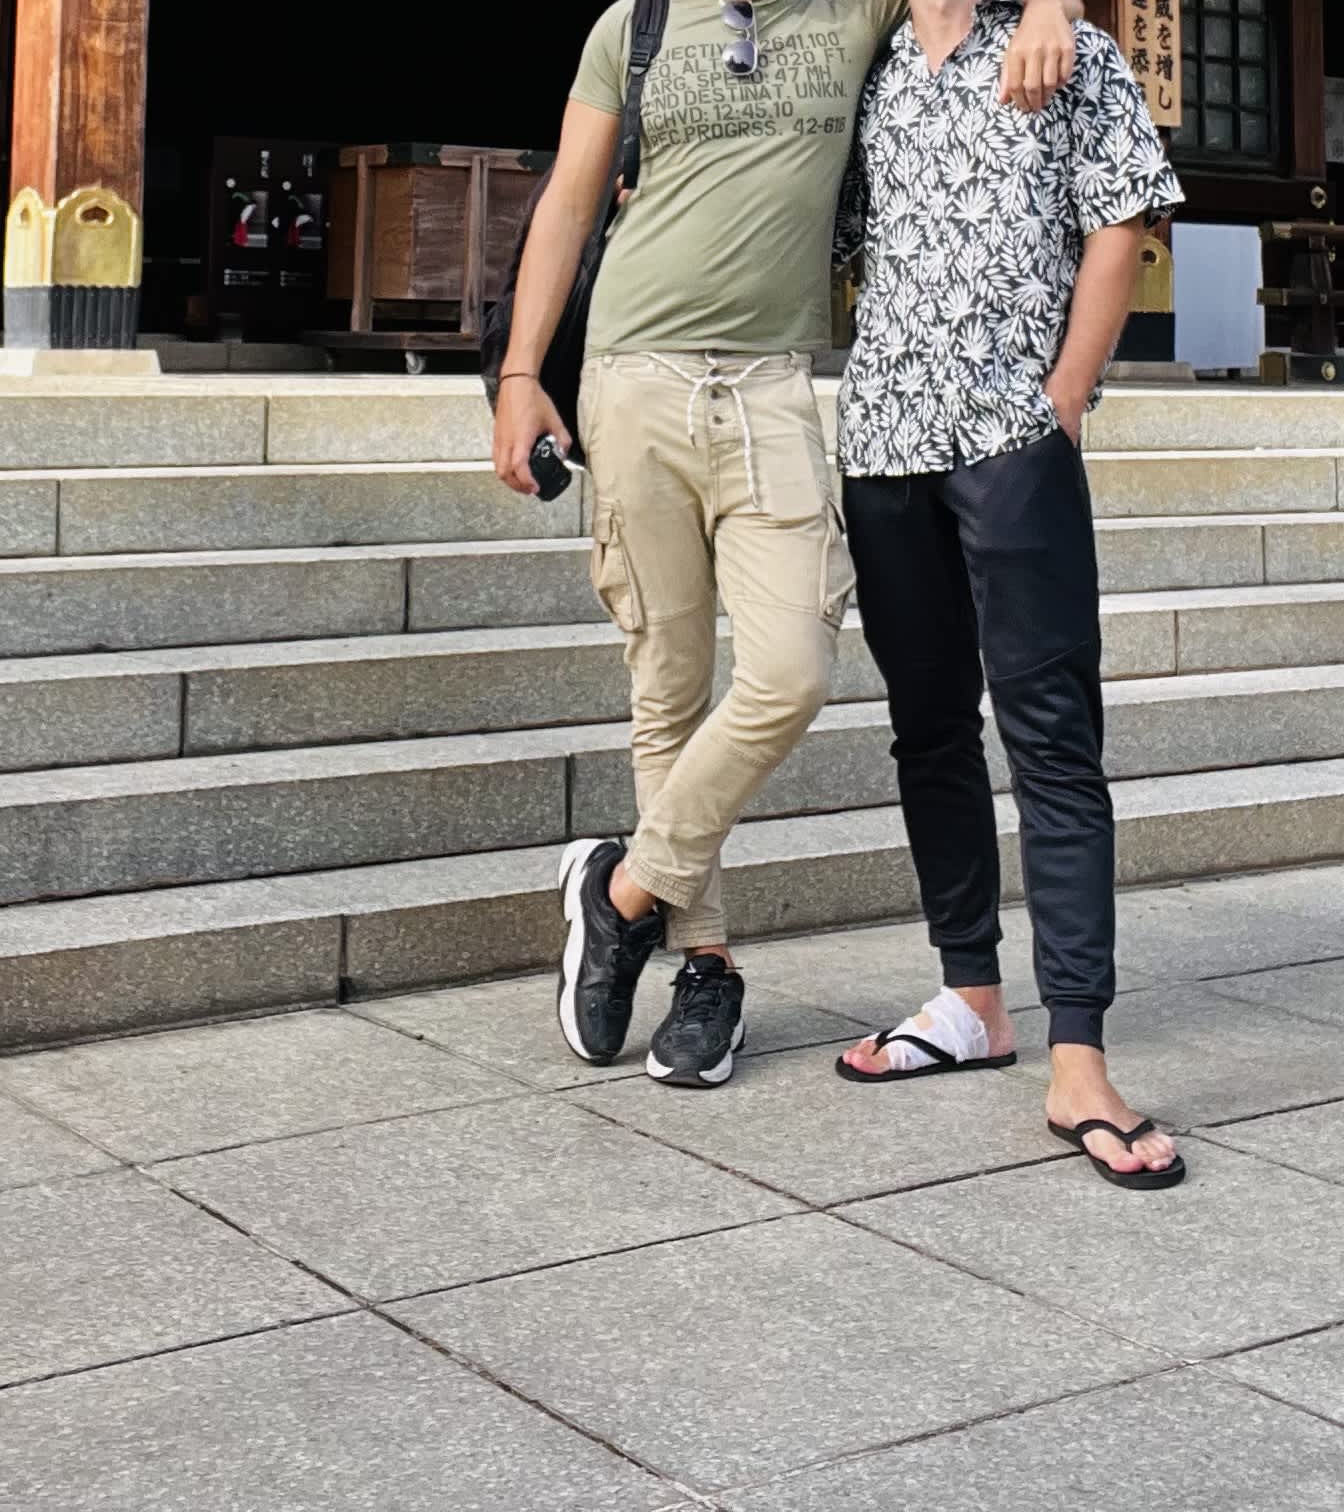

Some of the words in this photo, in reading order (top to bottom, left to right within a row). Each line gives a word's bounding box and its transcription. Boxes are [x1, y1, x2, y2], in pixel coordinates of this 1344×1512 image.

[647, 62, 676, 82] EQ.
[757, 49, 816, 69] 0-020
[823, 46, 853, 65] FT.
[774, 66, 800, 83] 47
